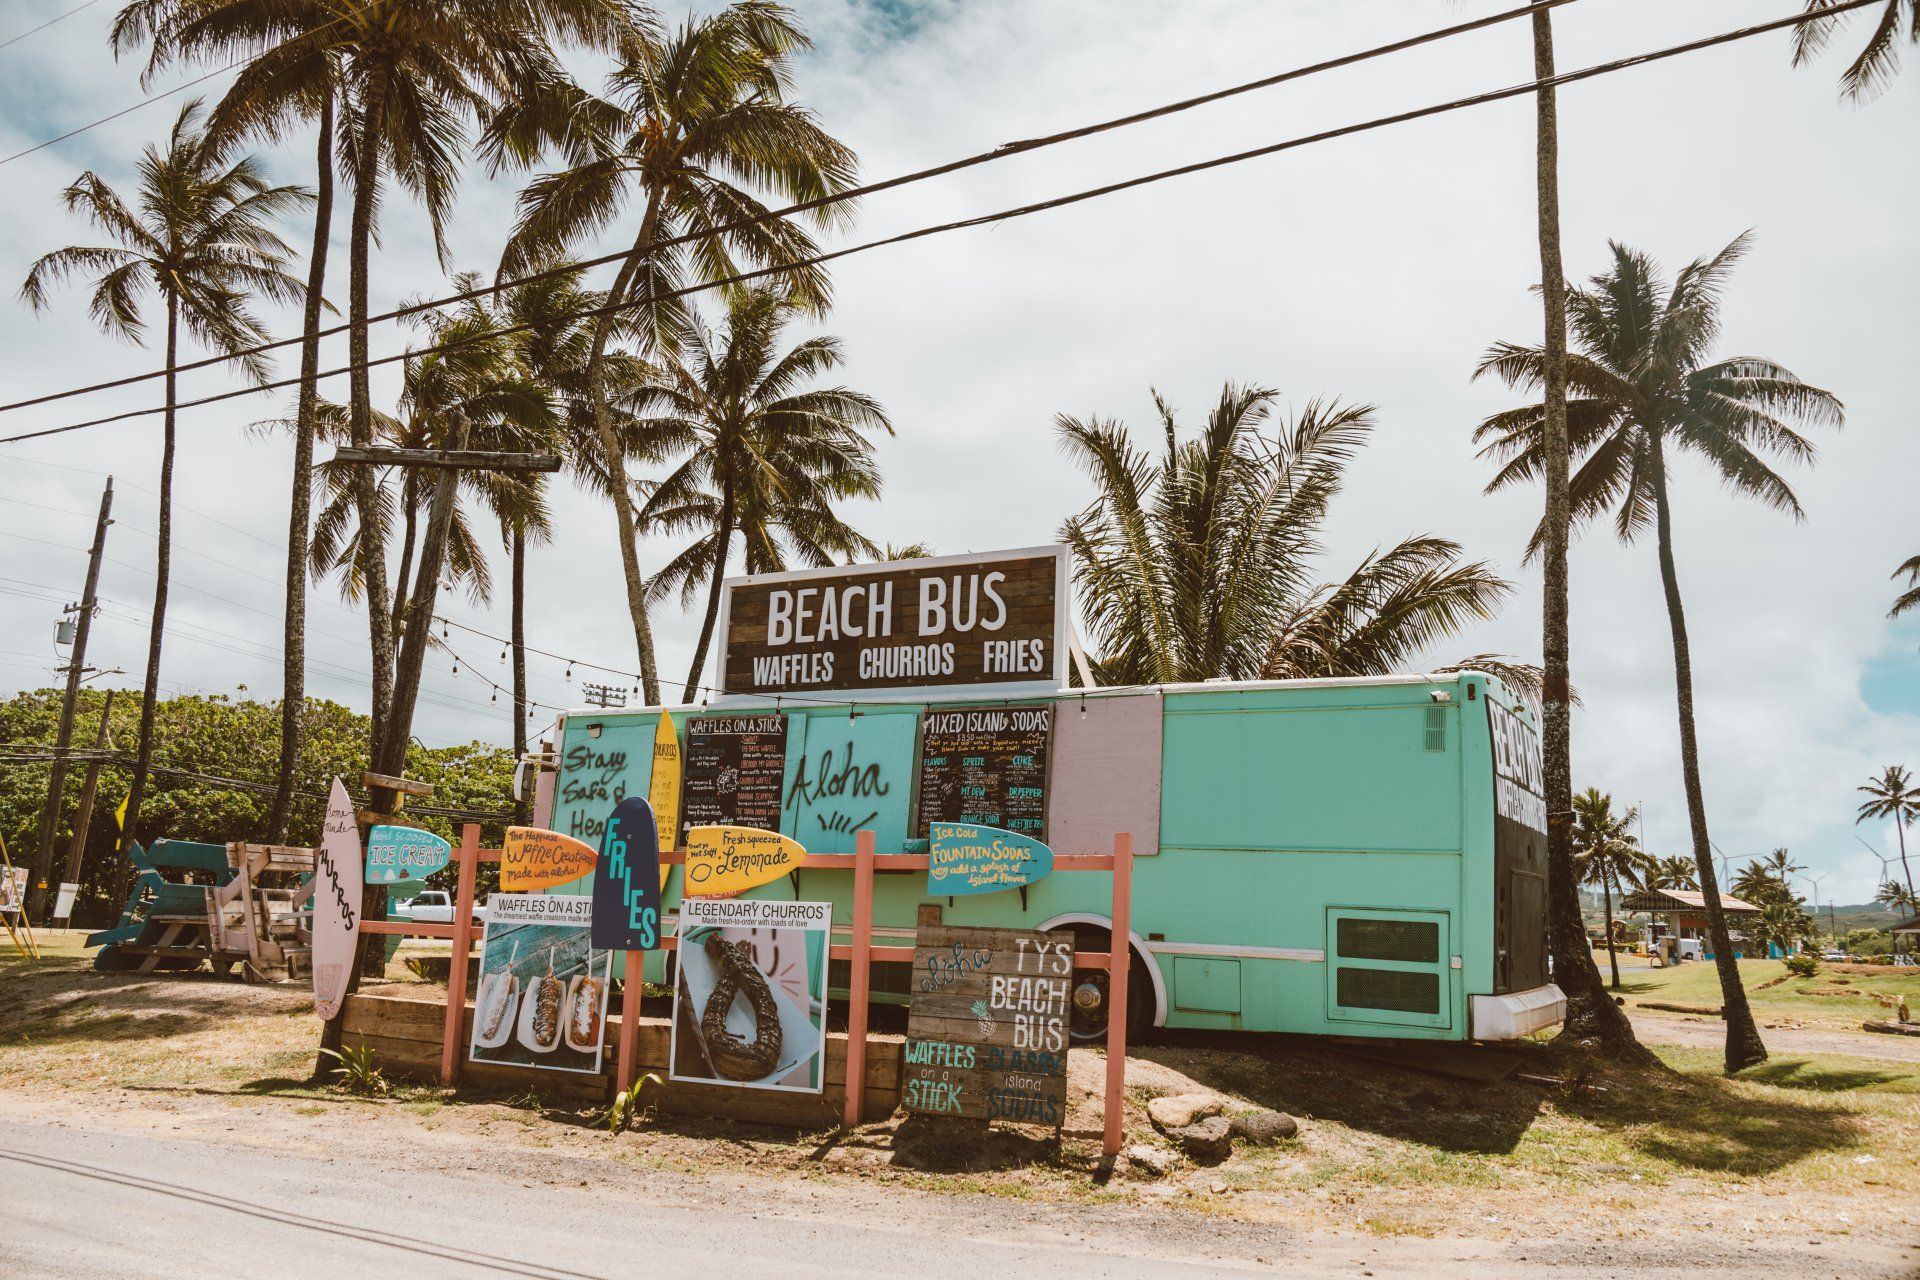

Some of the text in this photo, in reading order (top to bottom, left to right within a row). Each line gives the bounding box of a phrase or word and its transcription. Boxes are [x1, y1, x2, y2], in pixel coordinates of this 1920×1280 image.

[767, 571, 1007, 646] BEACH BUS
[753, 638, 1044, 686] WAFFLES CHURROS FRIES
[689, 718, 783, 734] WAFFLES ON A STICK
[923, 710, 1049, 734] MIXED ISLAND SODAS
[565, 746, 629, 785] Stay
[962, 757, 985, 766] SPRITE
[1012, 755, 1034, 766] COKE
[786, 741, 889, 810] Aloha
[562, 779, 609, 804] Safe
[326, 804, 356, 818] home
[323, 821, 358, 834] made
[372, 830, 391, 841] hand
[509, 830, 523, 842] The
[934, 827, 954, 840] Ice
[956, 828, 978, 838] Cold
[723, 831, 782, 848] Fresh squeezed
[371, 845, 446, 866] ICE CREAM
[507, 844, 594, 865] Waffle Creations
[716, 846, 791, 876] Lemonade
[931, 841, 1031, 864] FOUNTAIN SODAS
[506, 865, 580, 883] made with aloha!
[950, 863, 969, 874] add
[980, 862, 1009, 875] splash
[1011, 862, 1021, 873] of
[320, 848, 355, 931] HURROS
[604, 818, 656, 949] FRIES
[968, 875, 998, 887] island
[493, 911, 503, 919] The
[503, 912, 528, 920] dreamiest
[498, 898, 592, 915] WAFFLES ON A STI
[688, 902, 824, 920] LEGENDARY CHURROS
[701, 916, 717, 924] Made
[718, 917, 757, 926] fresh-to-order
[757, 918, 770, 926] with
[787, 919, 794, 927] of
[794, 919, 808, 927] love
[920, 940, 995, 993] aloha
[990, 976, 1066, 1016] BEACH
[1013, 1014, 1063, 1052] BUS
[905, 1040, 976, 1069] WAFFLES
[921, 1068, 949, 1081] on a
[1004, 1075, 1042, 1092] island
[905, 1078, 963, 1114] STICK
[987, 1086, 1058, 1124] SODAS
